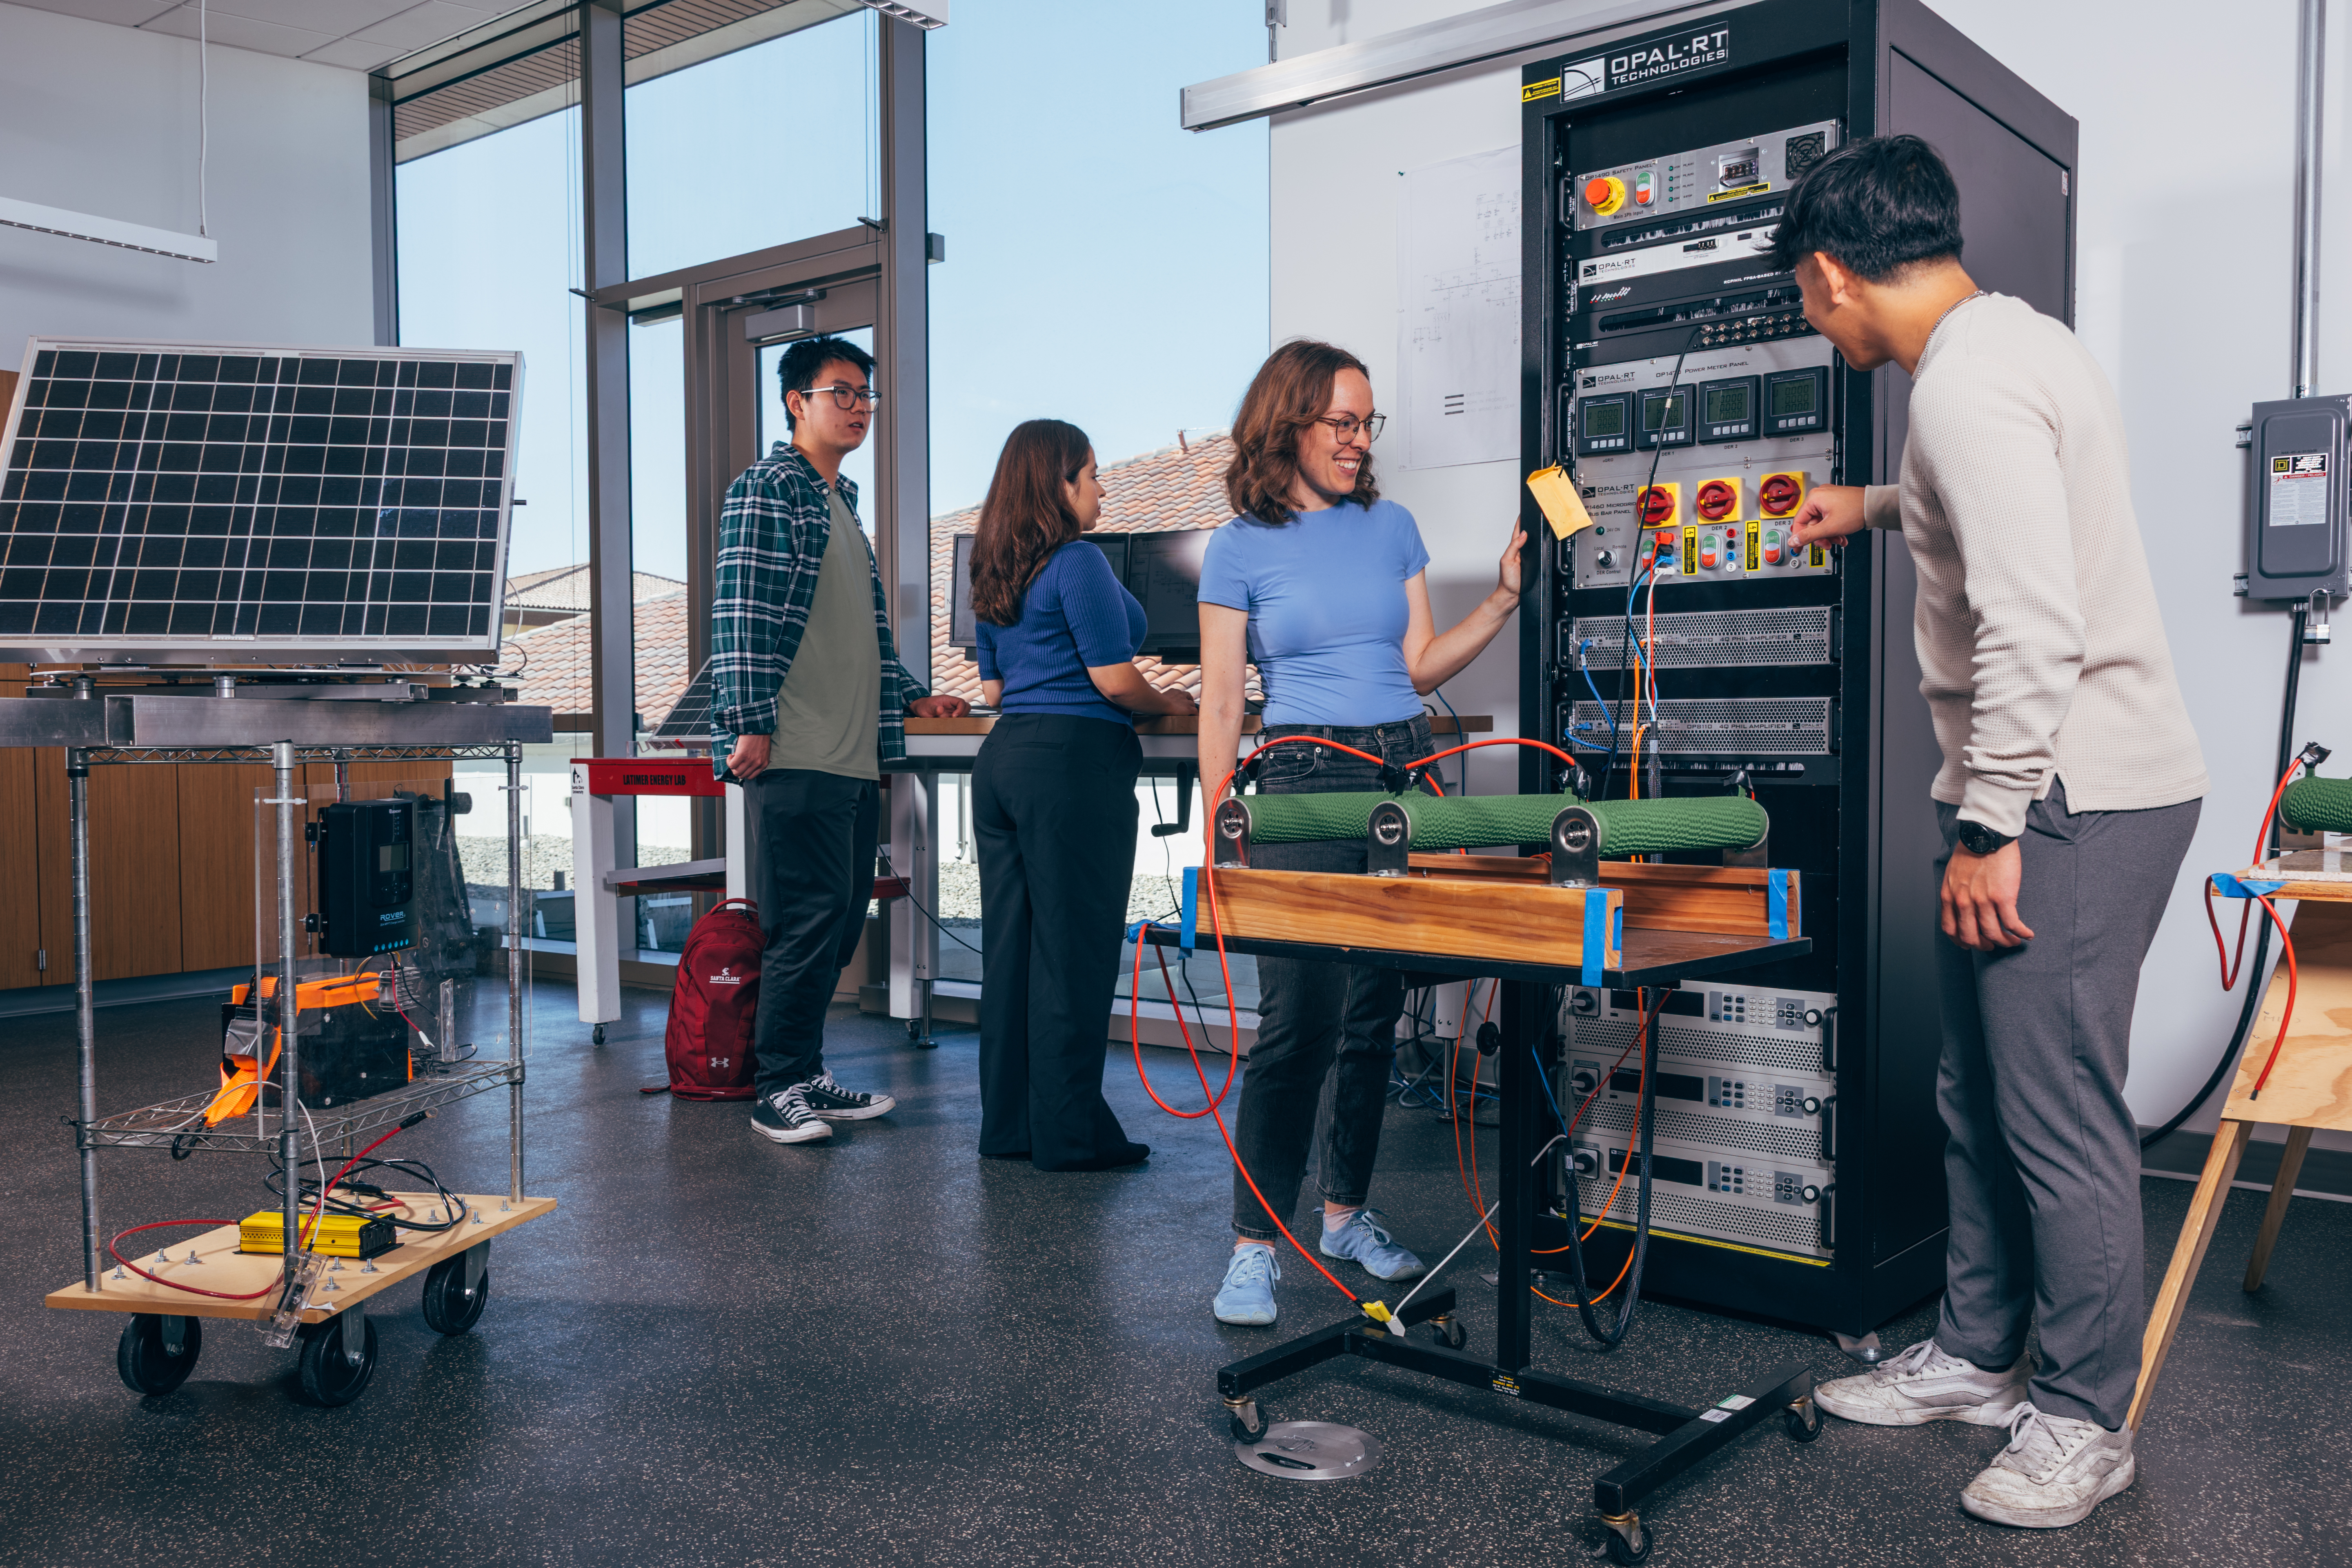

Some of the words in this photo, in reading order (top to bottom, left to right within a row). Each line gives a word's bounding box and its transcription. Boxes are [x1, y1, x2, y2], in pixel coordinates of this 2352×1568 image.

[1611, 30, 1727, 74] OPAL-RT
[1611, 49, 1725, 85] TECHNOLOGIES
[1585, 172, 1610, 181] OP1490
[1599, 258, 1636, 270] OPAL-RT
[1599, 264, 1635, 273] TECHNOLOGIES
[1598, 372, 1635, 382] OPAL-RT
[1598, 484, 1635, 493] OPAL-RT
[623, 774, 649, 785] LATIMER
[650, 775, 673, 785] ENERGY
[674, 775, 686, 785] LAB
[380, 911, 404, 921] ROVER
